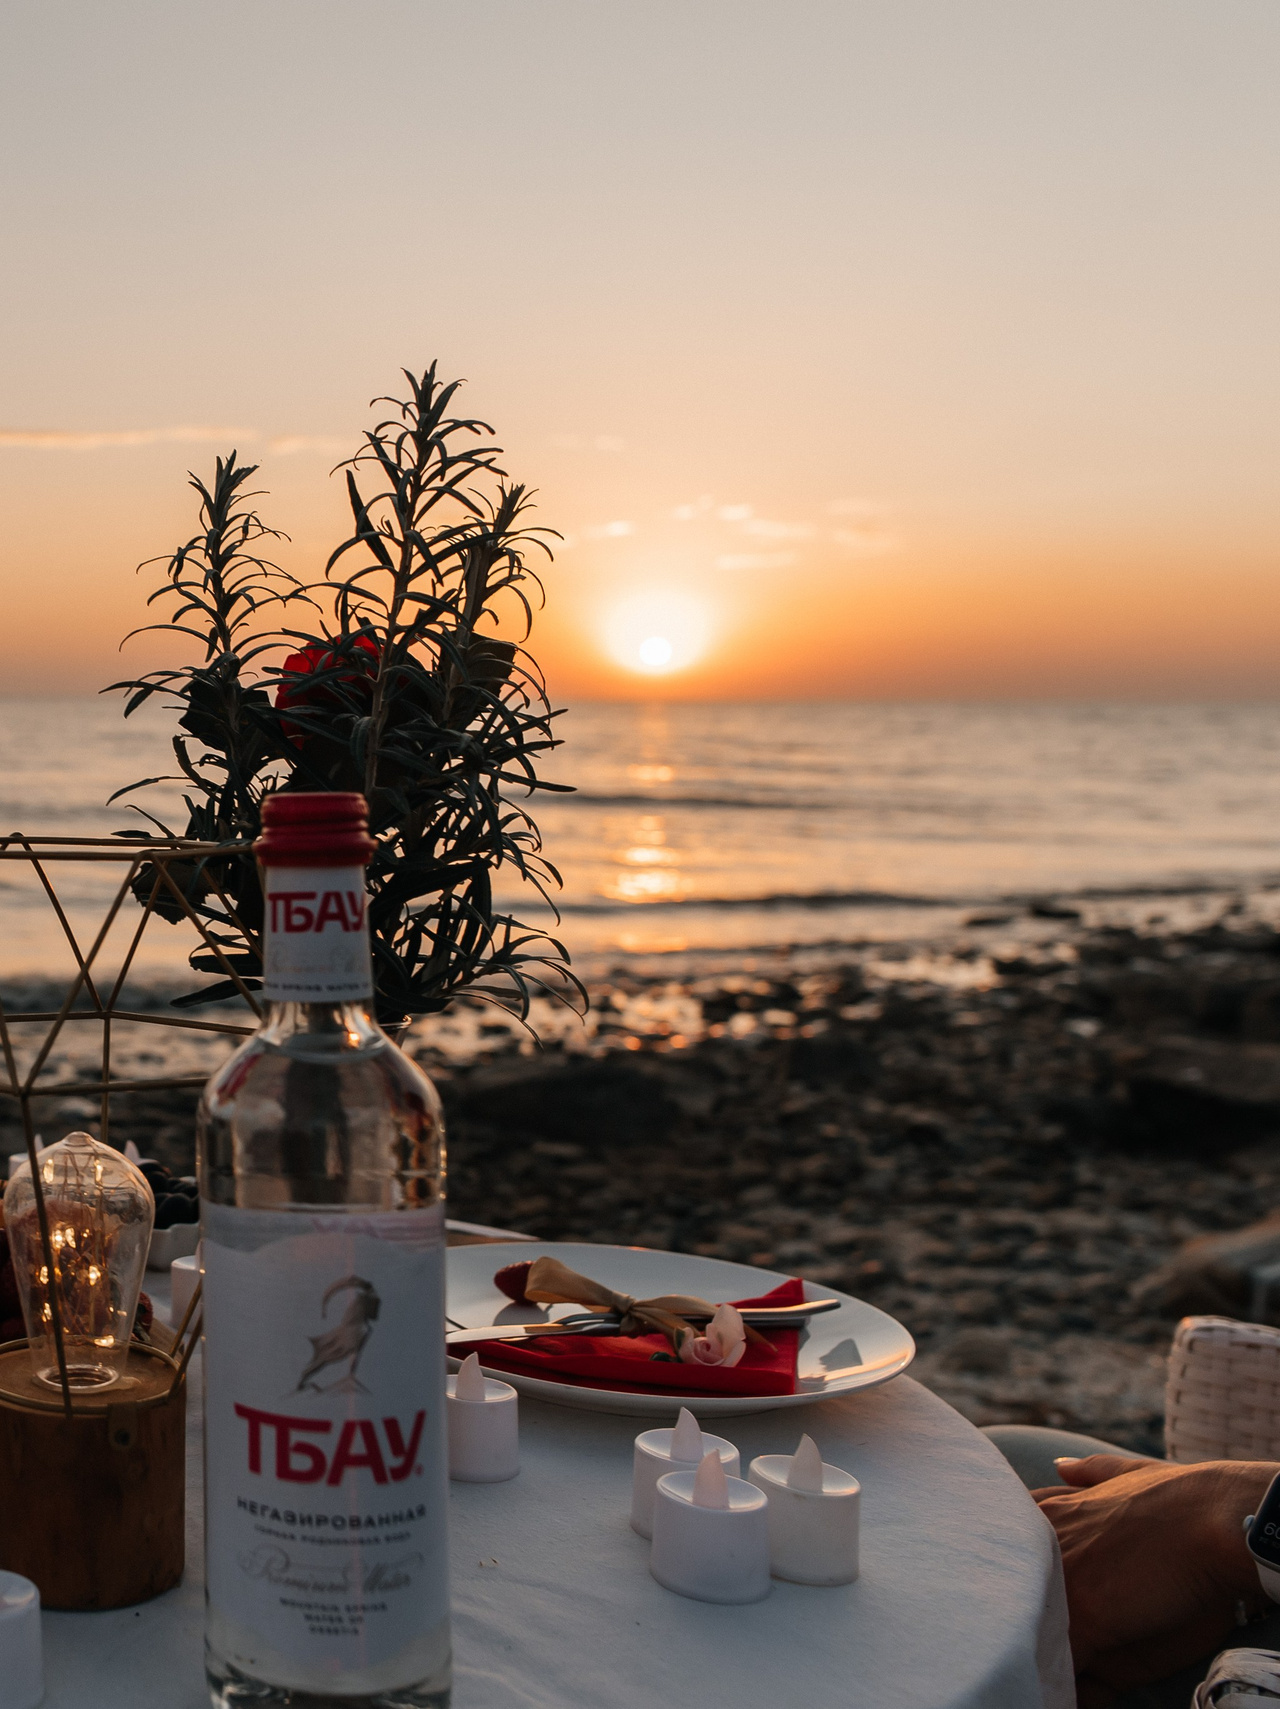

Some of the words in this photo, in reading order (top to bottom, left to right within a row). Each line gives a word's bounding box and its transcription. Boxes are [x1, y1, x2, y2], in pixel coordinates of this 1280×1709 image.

[268, 890, 365, 934] ТБАУ
[233, 1403, 426, 1488] ТБАУ
[236, 1495, 427, 1531] НЕГАЗИРОВАННАЯ
